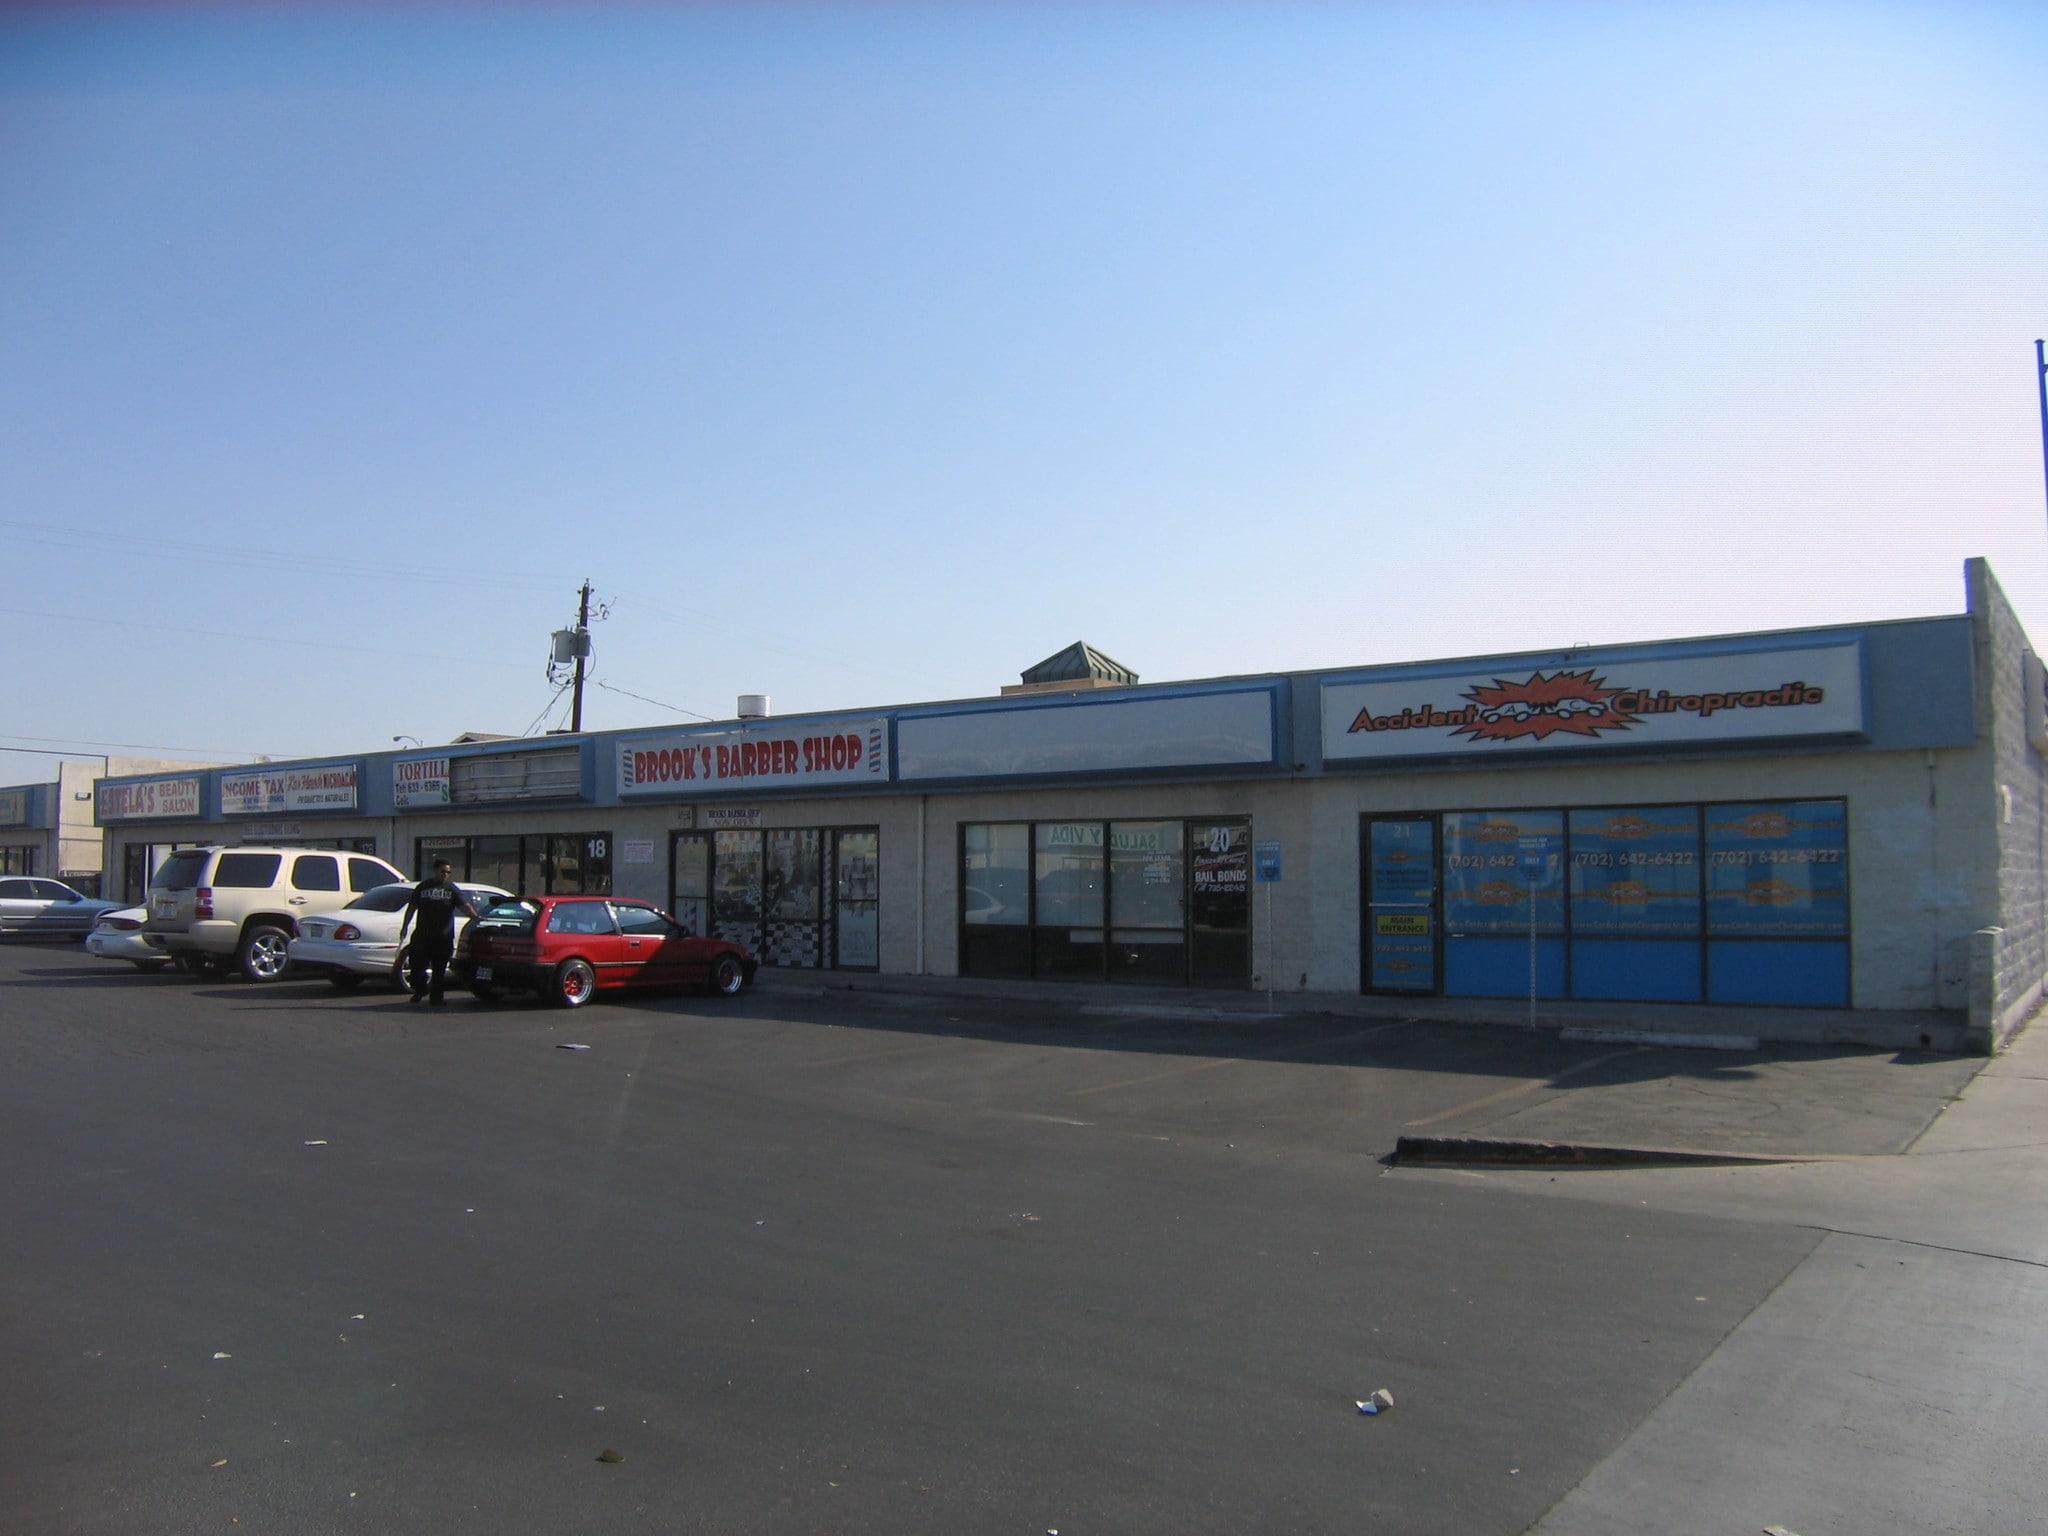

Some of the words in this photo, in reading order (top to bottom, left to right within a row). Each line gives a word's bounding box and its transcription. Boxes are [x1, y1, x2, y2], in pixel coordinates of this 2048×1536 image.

[1610, 681, 1824, 717] Chiropractic
[1348, 704, 1478, 733] Accident
[635, 744, 711, 783] BROOK'S
[716, 739, 799, 778] BARBER
[803, 734, 862, 773] SHOP
[398, 761, 450, 780] TORTILL
[160, 781, 197, 797] BEAUTY
[223, 780, 261, 797] INCOME
[264, 778, 285, 794] TAX
[101, 785, 155, 815] ESTELA'S
[162, 799, 194, 813] SALON
[1210, 827, 1230, 852] 20
[1394, 825, 1410, 838] 21
[588, 839, 606, 858] 18
[1448, 855, 1485, 869] (702)
[1489, 854, 1558, 867] 642-2
[1575, 853, 1615, 867] (702)
[1619, 852, 1694, 867] 642-6422
[1711, 851, 1752, 867] (702)
[1759, 850, 1840, 865] 642-6422
[1195, 871, 1216, 882] BAIL
[1217, 870, 1247, 882] BONDS
[1380, 925, 1425, 933] ENTRANCE
[1390, 917, 1414, 925] MAIN
